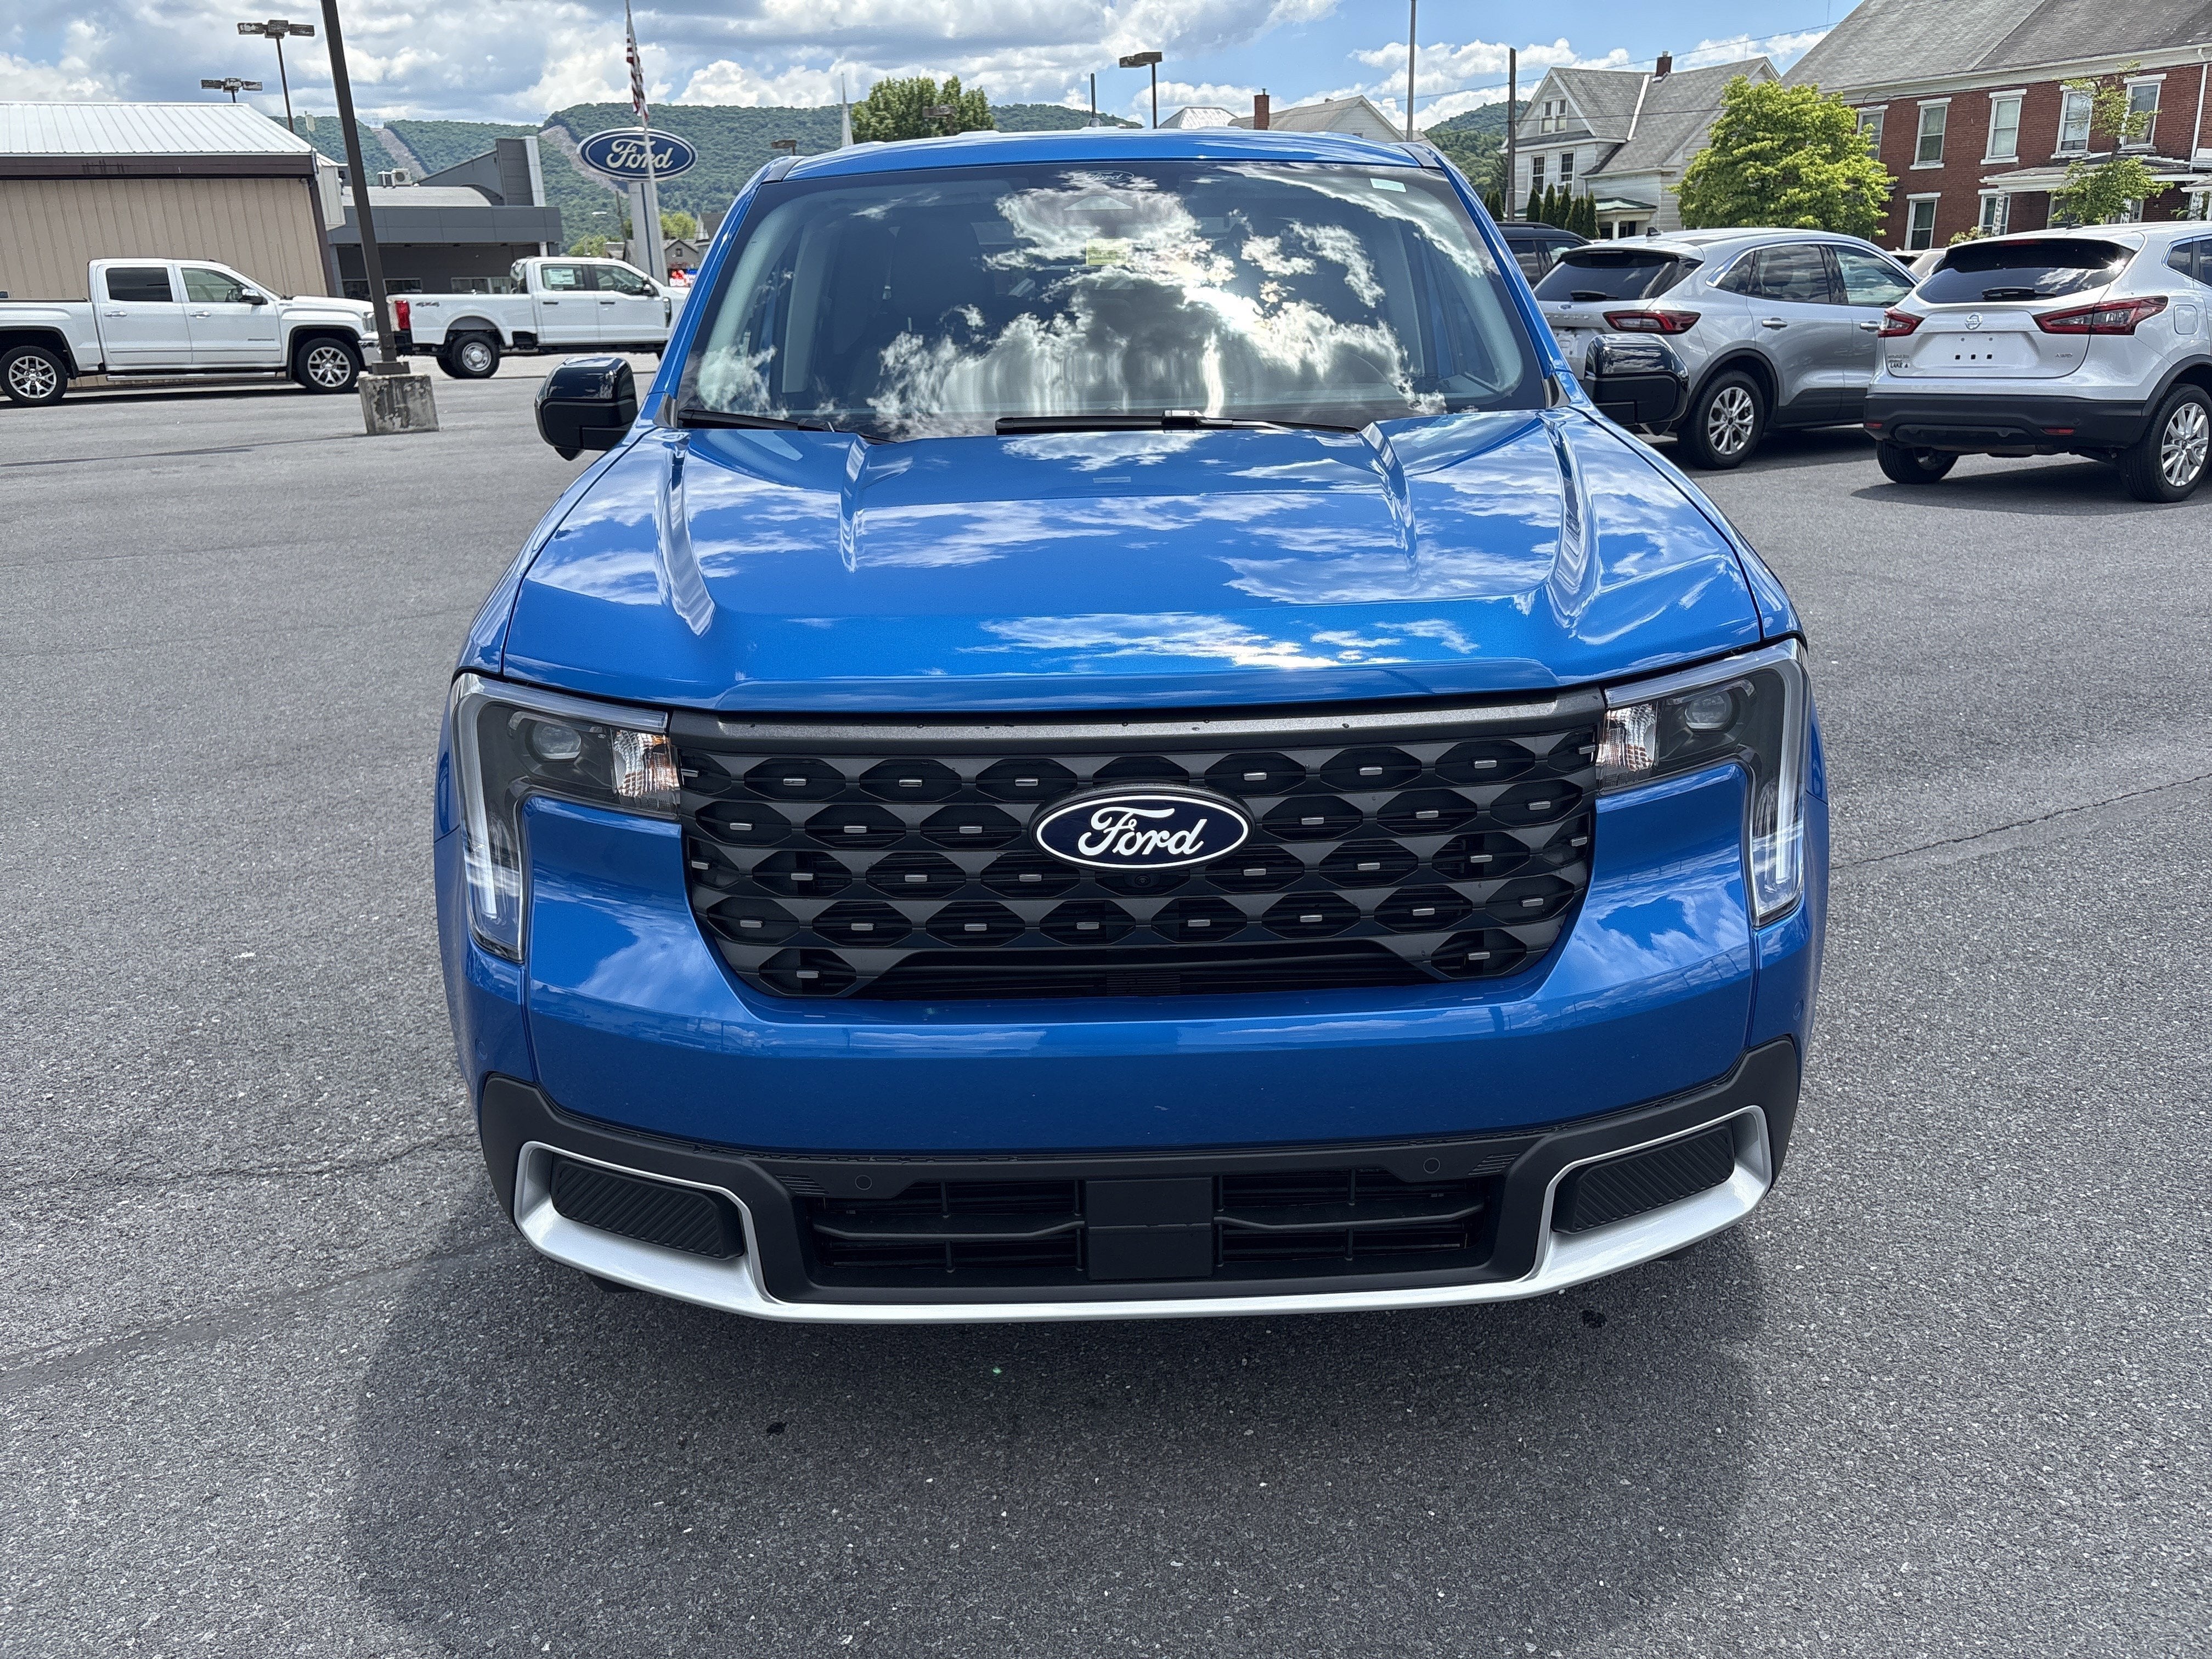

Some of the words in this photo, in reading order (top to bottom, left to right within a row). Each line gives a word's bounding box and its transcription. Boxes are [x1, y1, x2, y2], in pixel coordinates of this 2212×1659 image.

[606, 139, 674, 168] Ford
[1085, 172, 1123, 181] Ford
[1078, 806, 1207, 856] Ford
